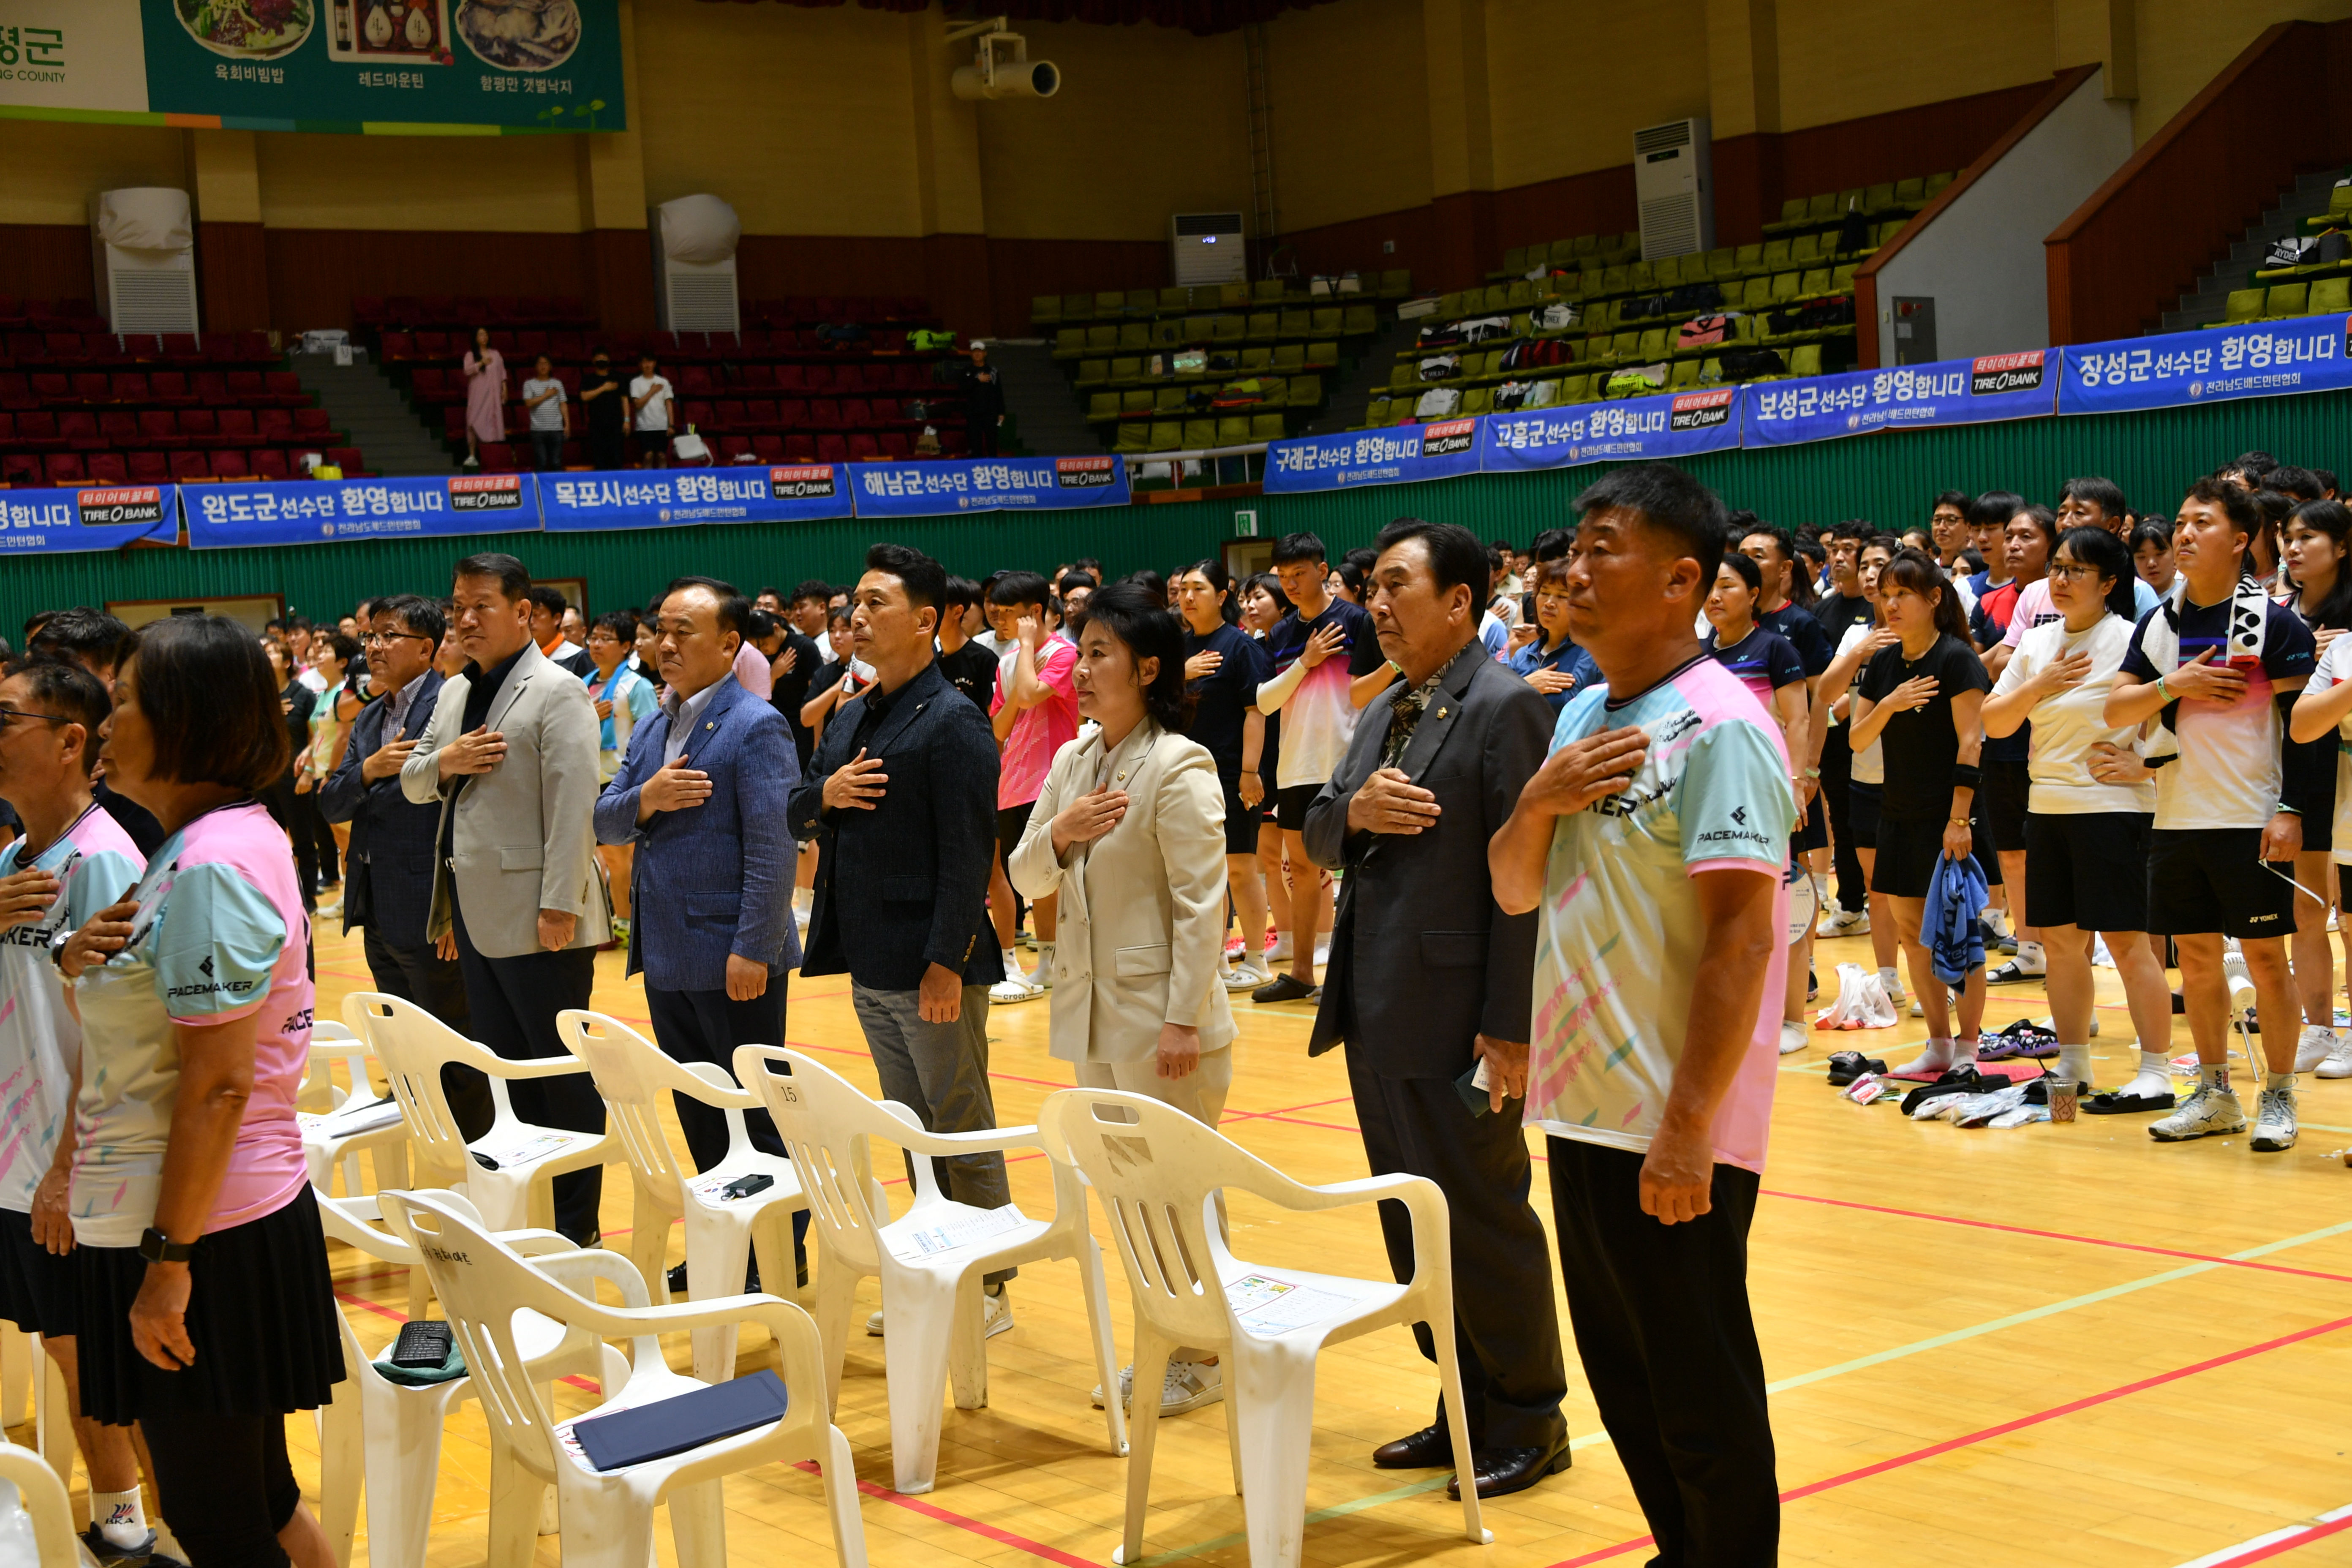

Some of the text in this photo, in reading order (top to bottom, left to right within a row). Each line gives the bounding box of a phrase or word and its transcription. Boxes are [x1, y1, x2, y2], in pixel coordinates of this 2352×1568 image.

[16, 68, 65, 83] COUNTY
[215, 64, 284, 84] 육회비빔밥
[359, 71, 423, 88] 레드마운틴
[480, 75, 572, 94] 함평만 갯벌낙지
[2274, 247, 2300, 262] RYDER
[2220, 334, 2336, 370] 환영합니다
[1607, 382, 1636, 390] DUNLOP
[1872, 370, 1964, 403] 환영합니다
[2206, 372, 2300, 394] 전라남도배드민턴협회
[1590, 408, 1665, 438] 환영합니다
[1355, 437, 1418, 464] 환영합니다
[972, 466, 1052, 490] 환영합니다
[676, 476, 765, 502] 환영합니다
[341, 487, 443, 515] 환영합니다
[1696, 830, 1769, 845] PACEMAKER
[2259, 912, 2278, 922] YONEX
[168, 980, 253, 998] PACEMAKER
[780, 1086, 797, 1102] 15
